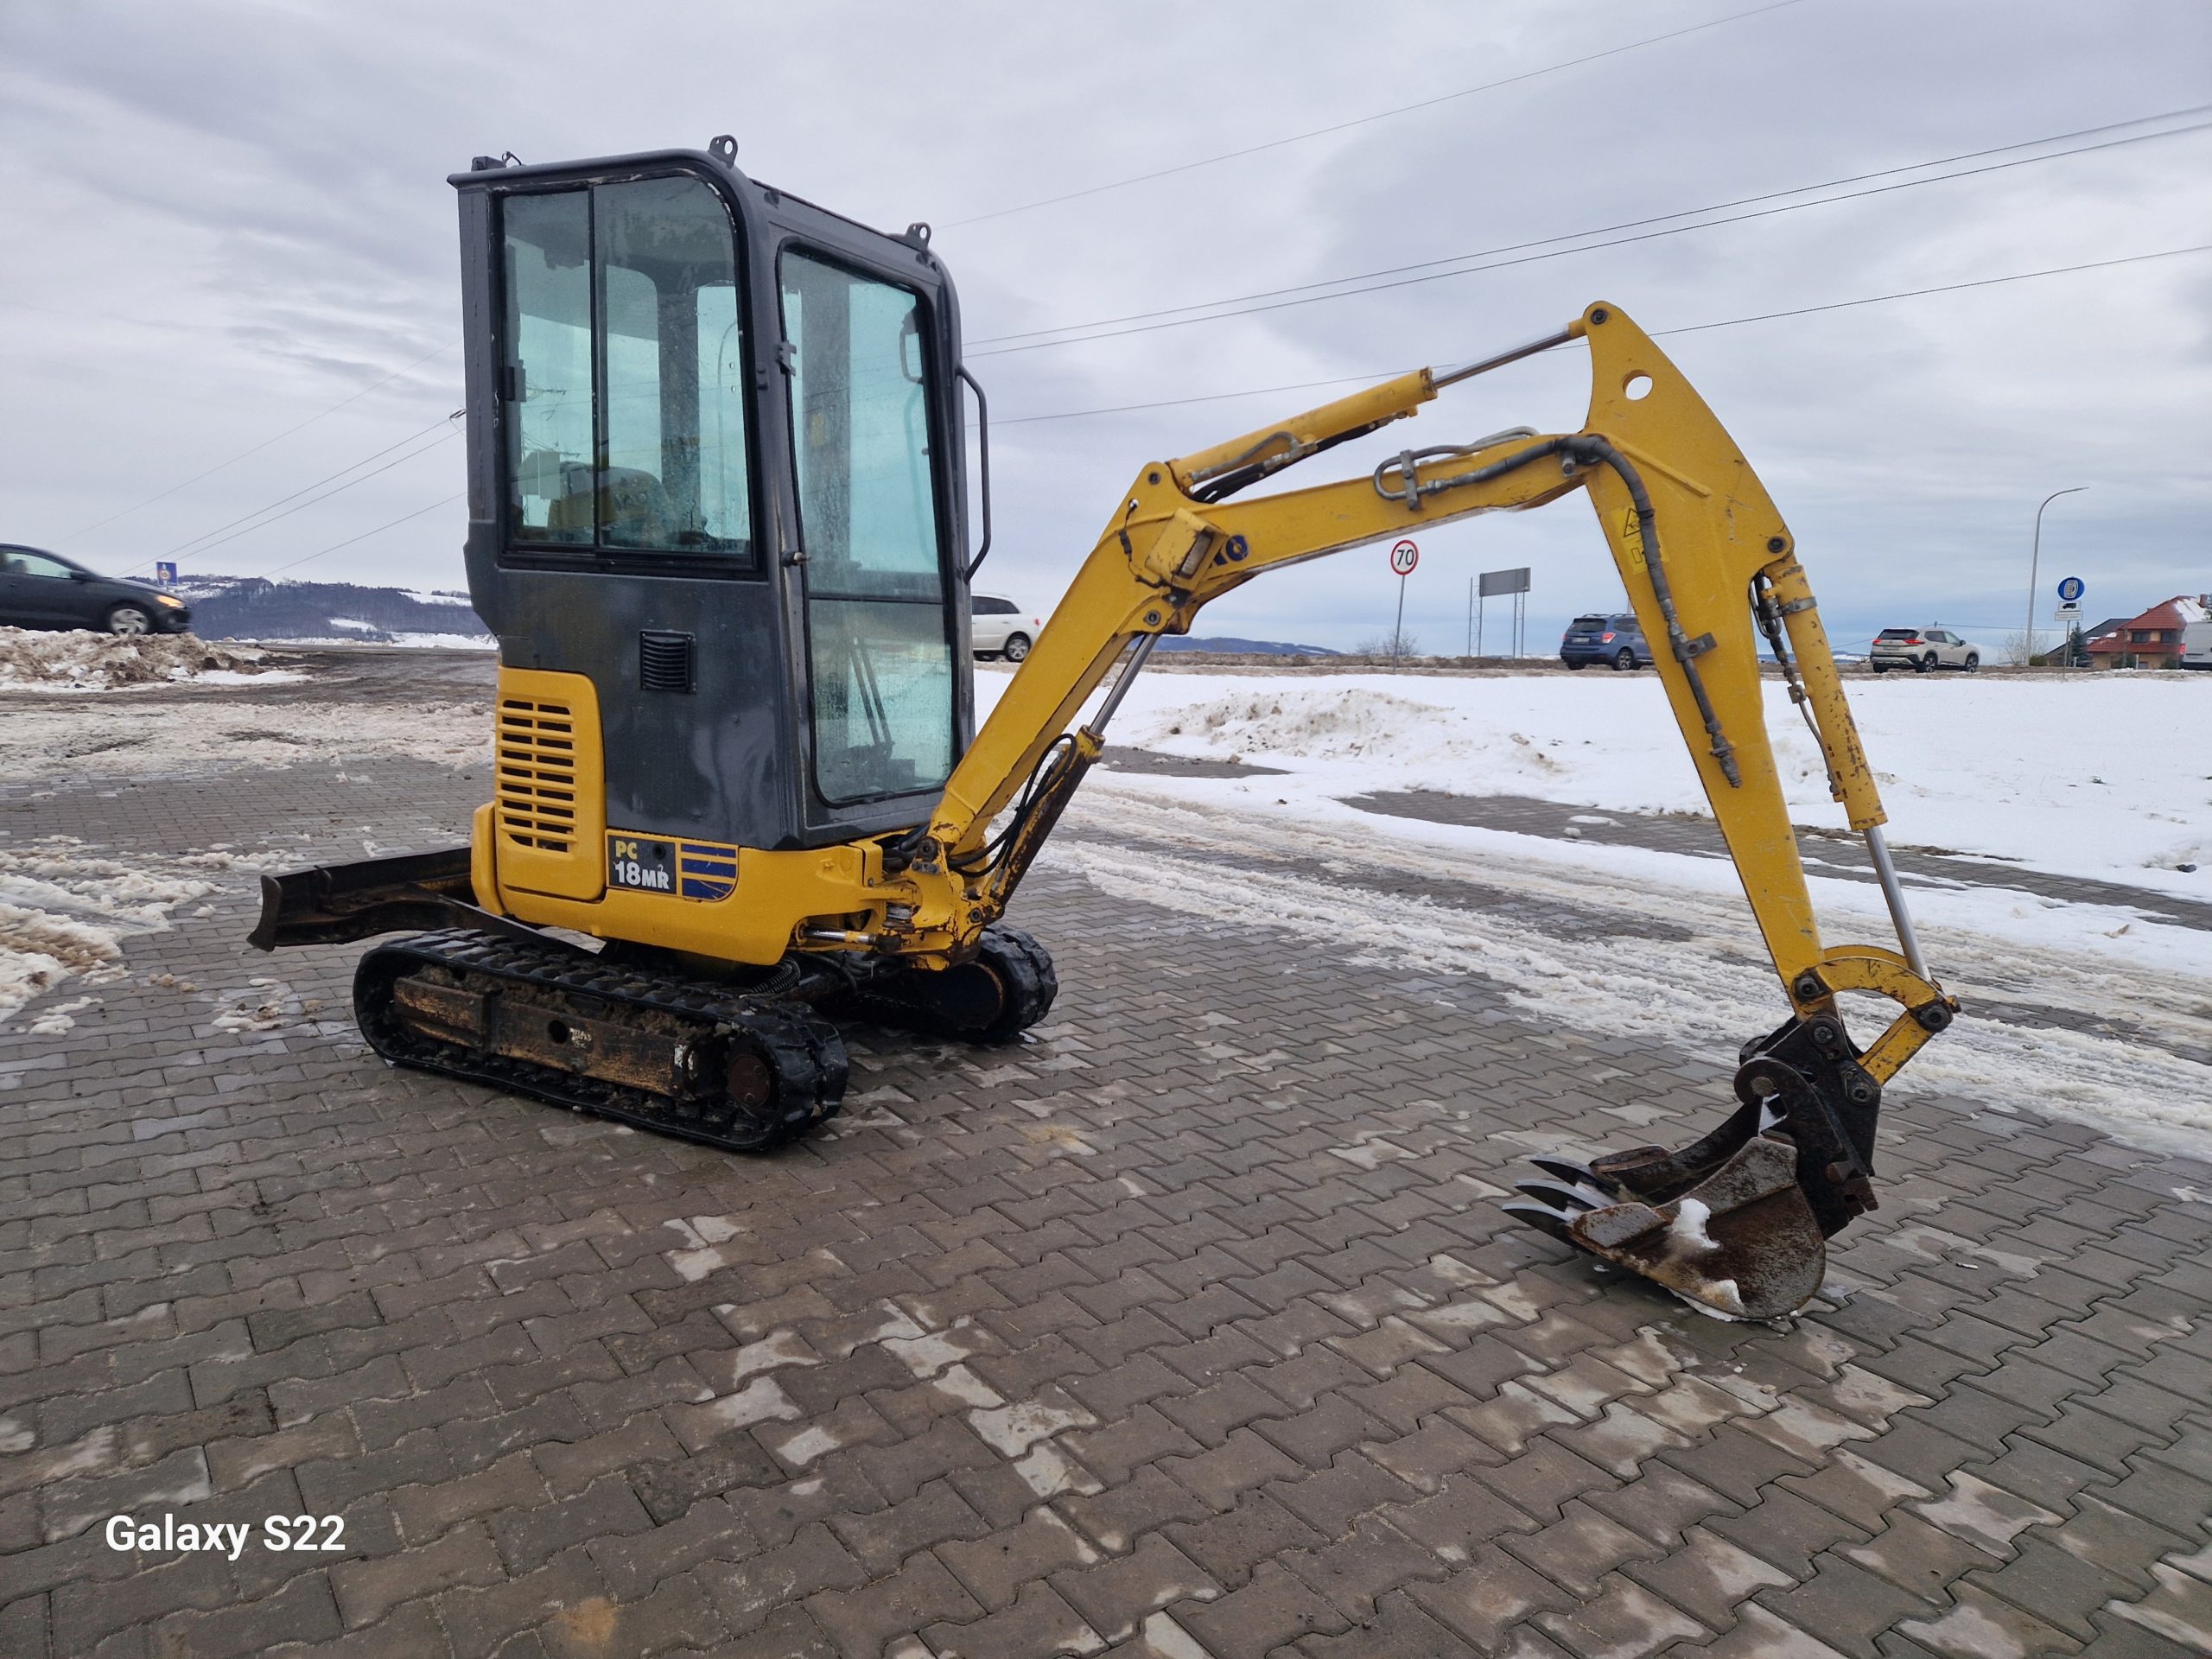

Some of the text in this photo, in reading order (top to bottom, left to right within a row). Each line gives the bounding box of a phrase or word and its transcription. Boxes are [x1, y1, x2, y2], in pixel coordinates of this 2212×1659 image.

[1397, 549, 1414, 566] 70
[615, 841, 637, 860] PC
[614, 861, 670, 889] 18MR
